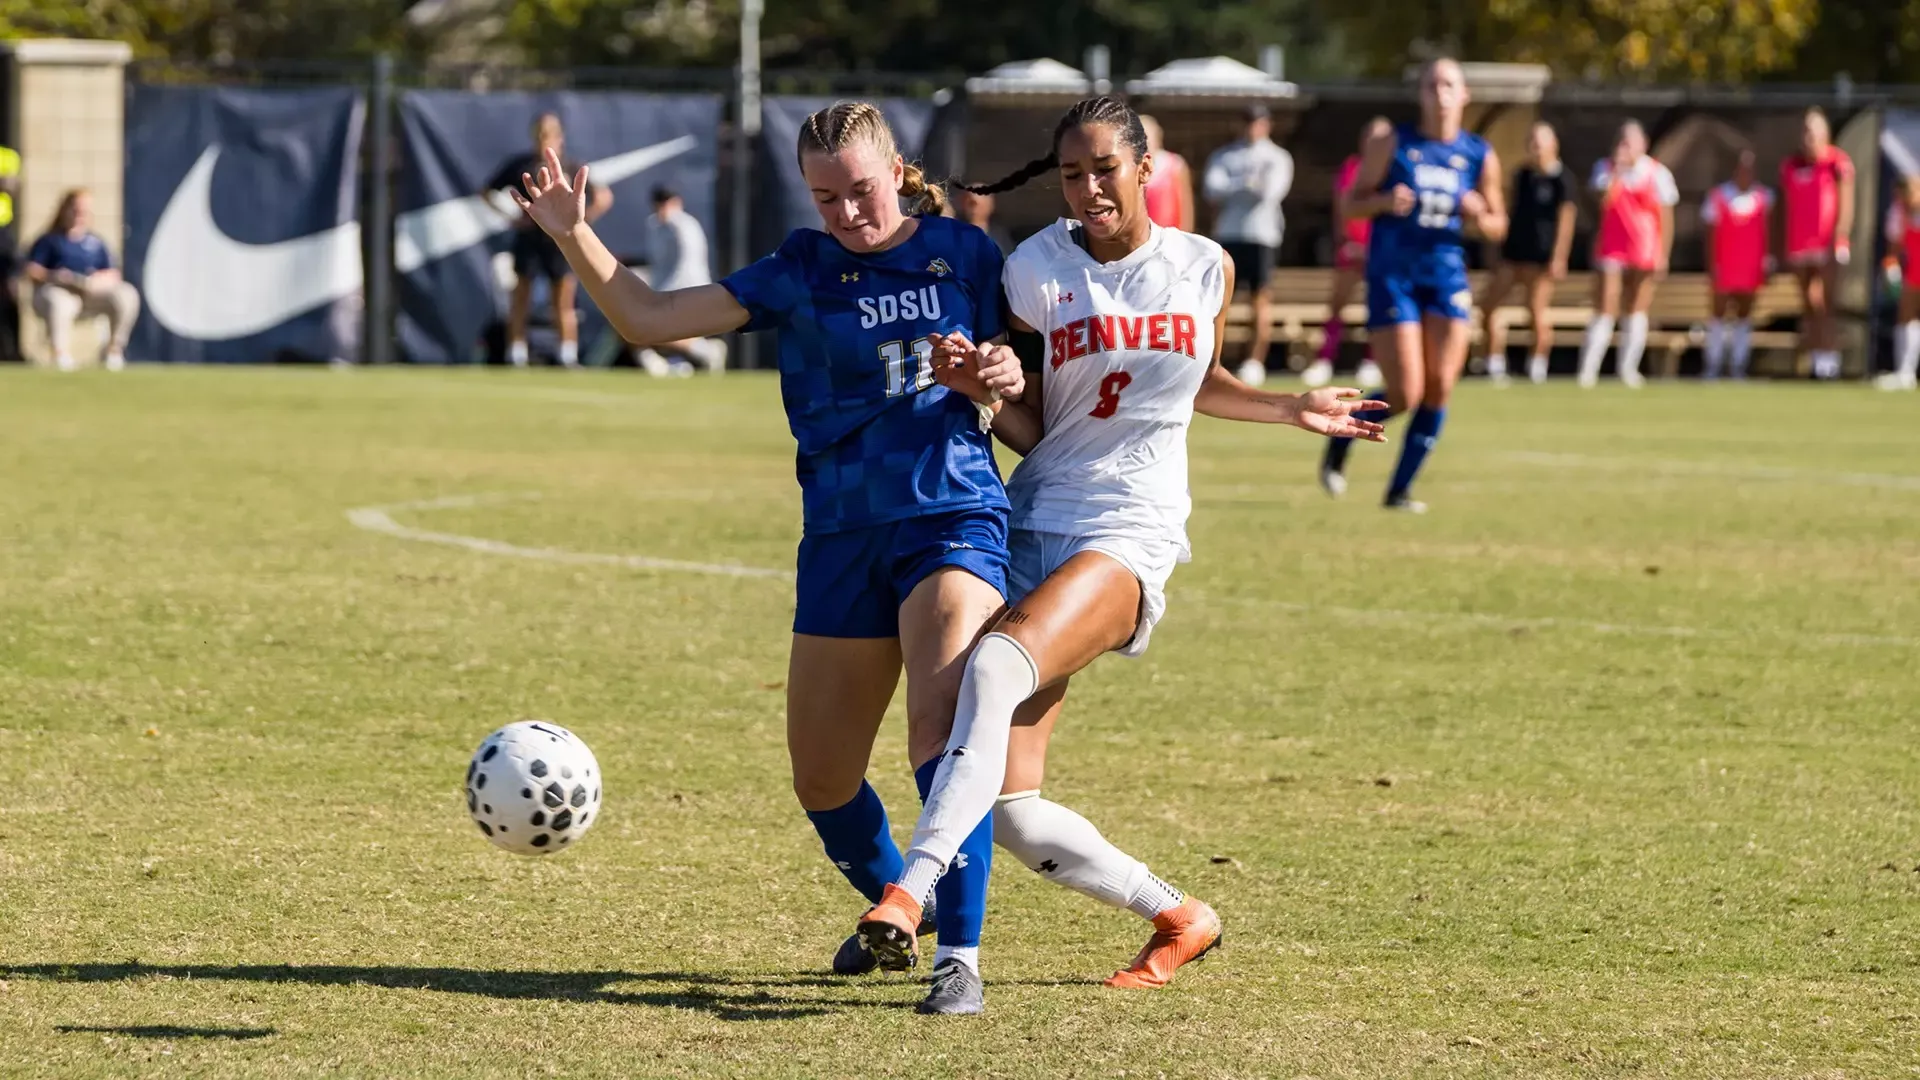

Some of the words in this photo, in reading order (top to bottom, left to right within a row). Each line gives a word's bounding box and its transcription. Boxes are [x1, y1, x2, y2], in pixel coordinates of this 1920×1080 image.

[858, 285, 941, 330] SDSU
[877, 337, 935, 398] 11
[1050, 312, 1197, 372] DENVER
